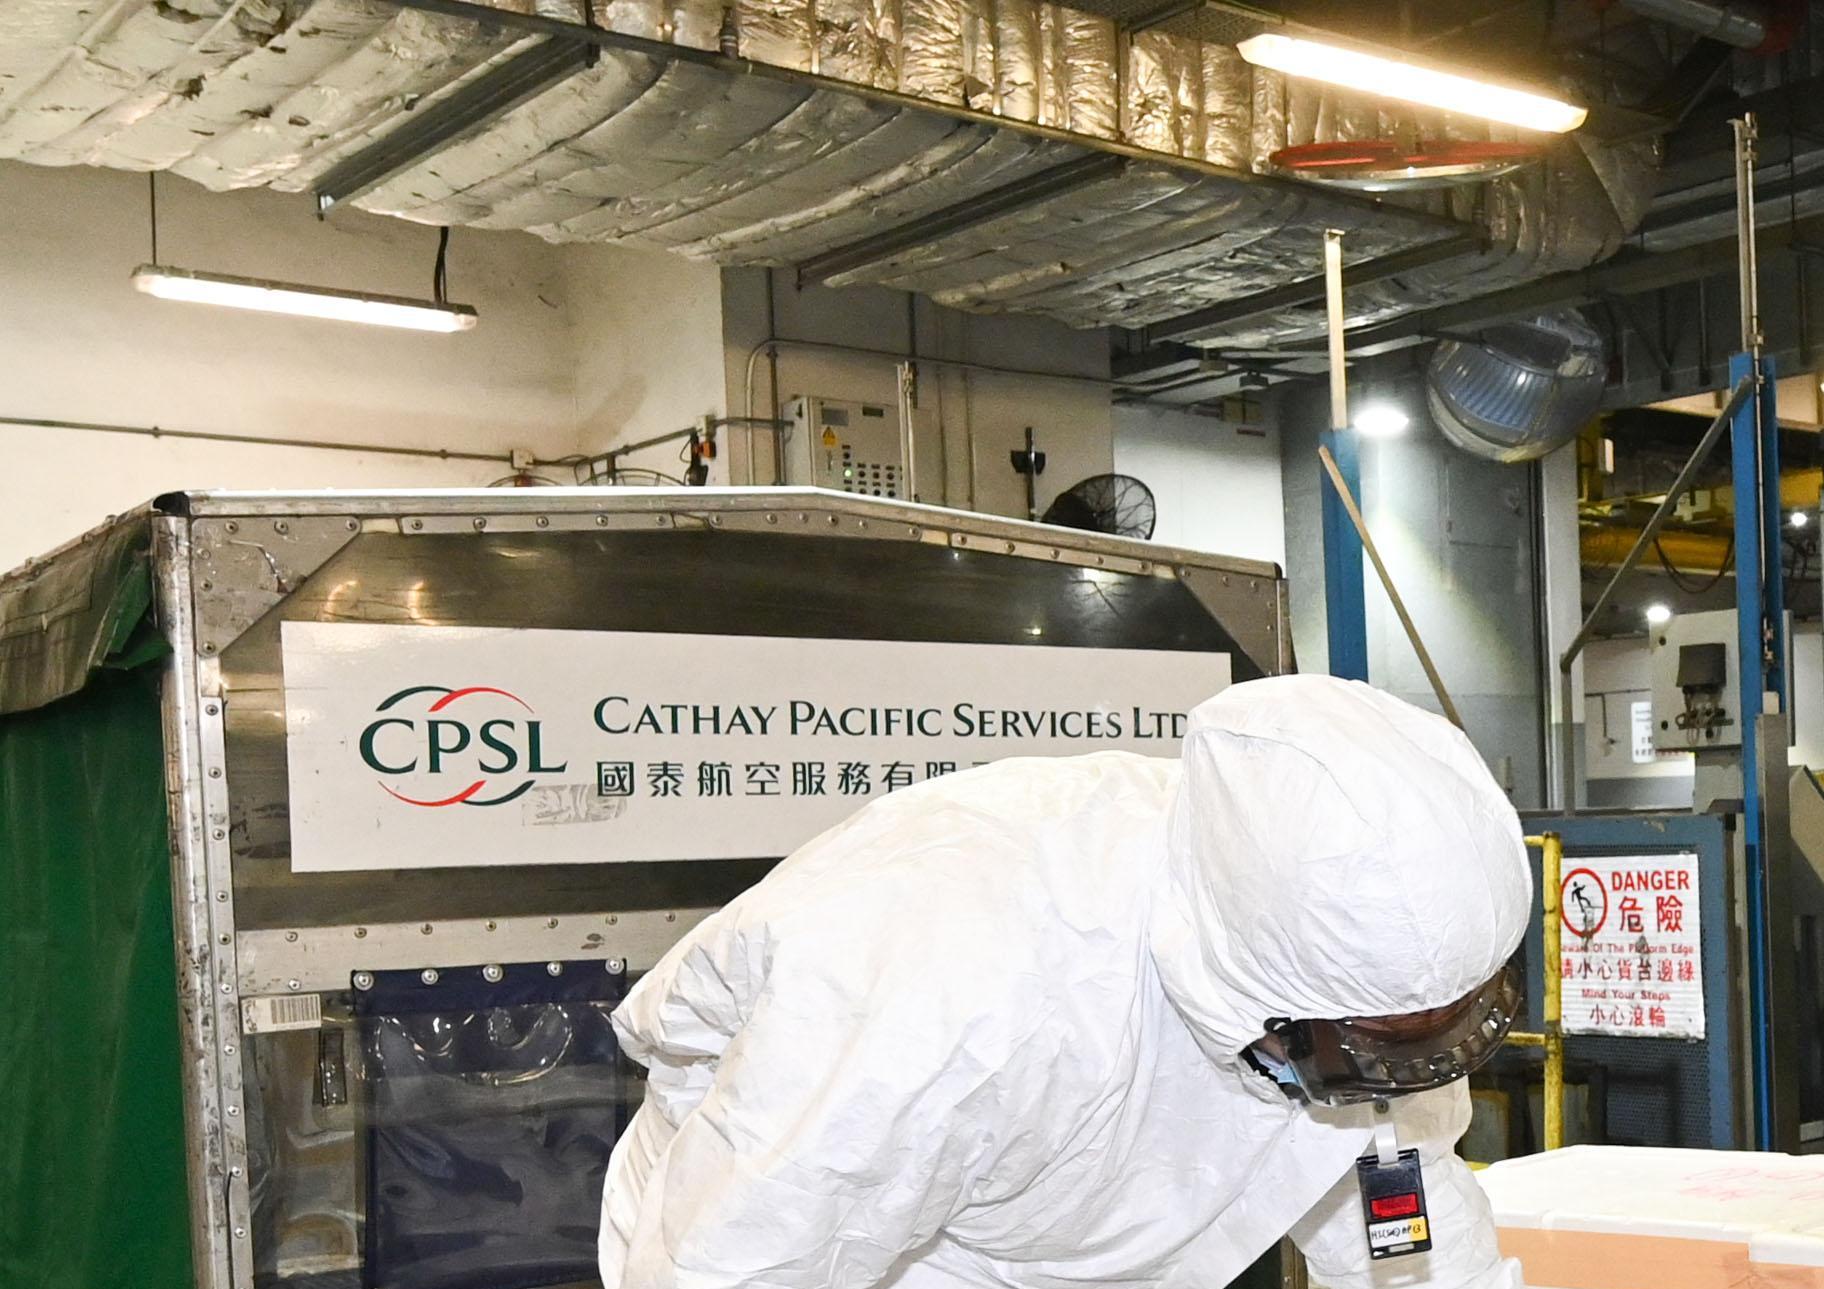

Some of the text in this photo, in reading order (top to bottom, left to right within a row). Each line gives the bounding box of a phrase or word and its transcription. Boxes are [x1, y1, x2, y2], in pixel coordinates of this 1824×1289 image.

[594, 695, 776, 738] CATHAY
[790, 700, 943, 739] PACIFIC
[953, 703, 1123, 740] SERVICES
[358, 713, 569, 776] CPSL
[1611, 870, 1690, 891] DANGER
[1618, 894, 1683, 934] 危險
[1672, 943, 1694, 955] Edge
[1581, 988, 1671, 1001] Mind Your Steps
